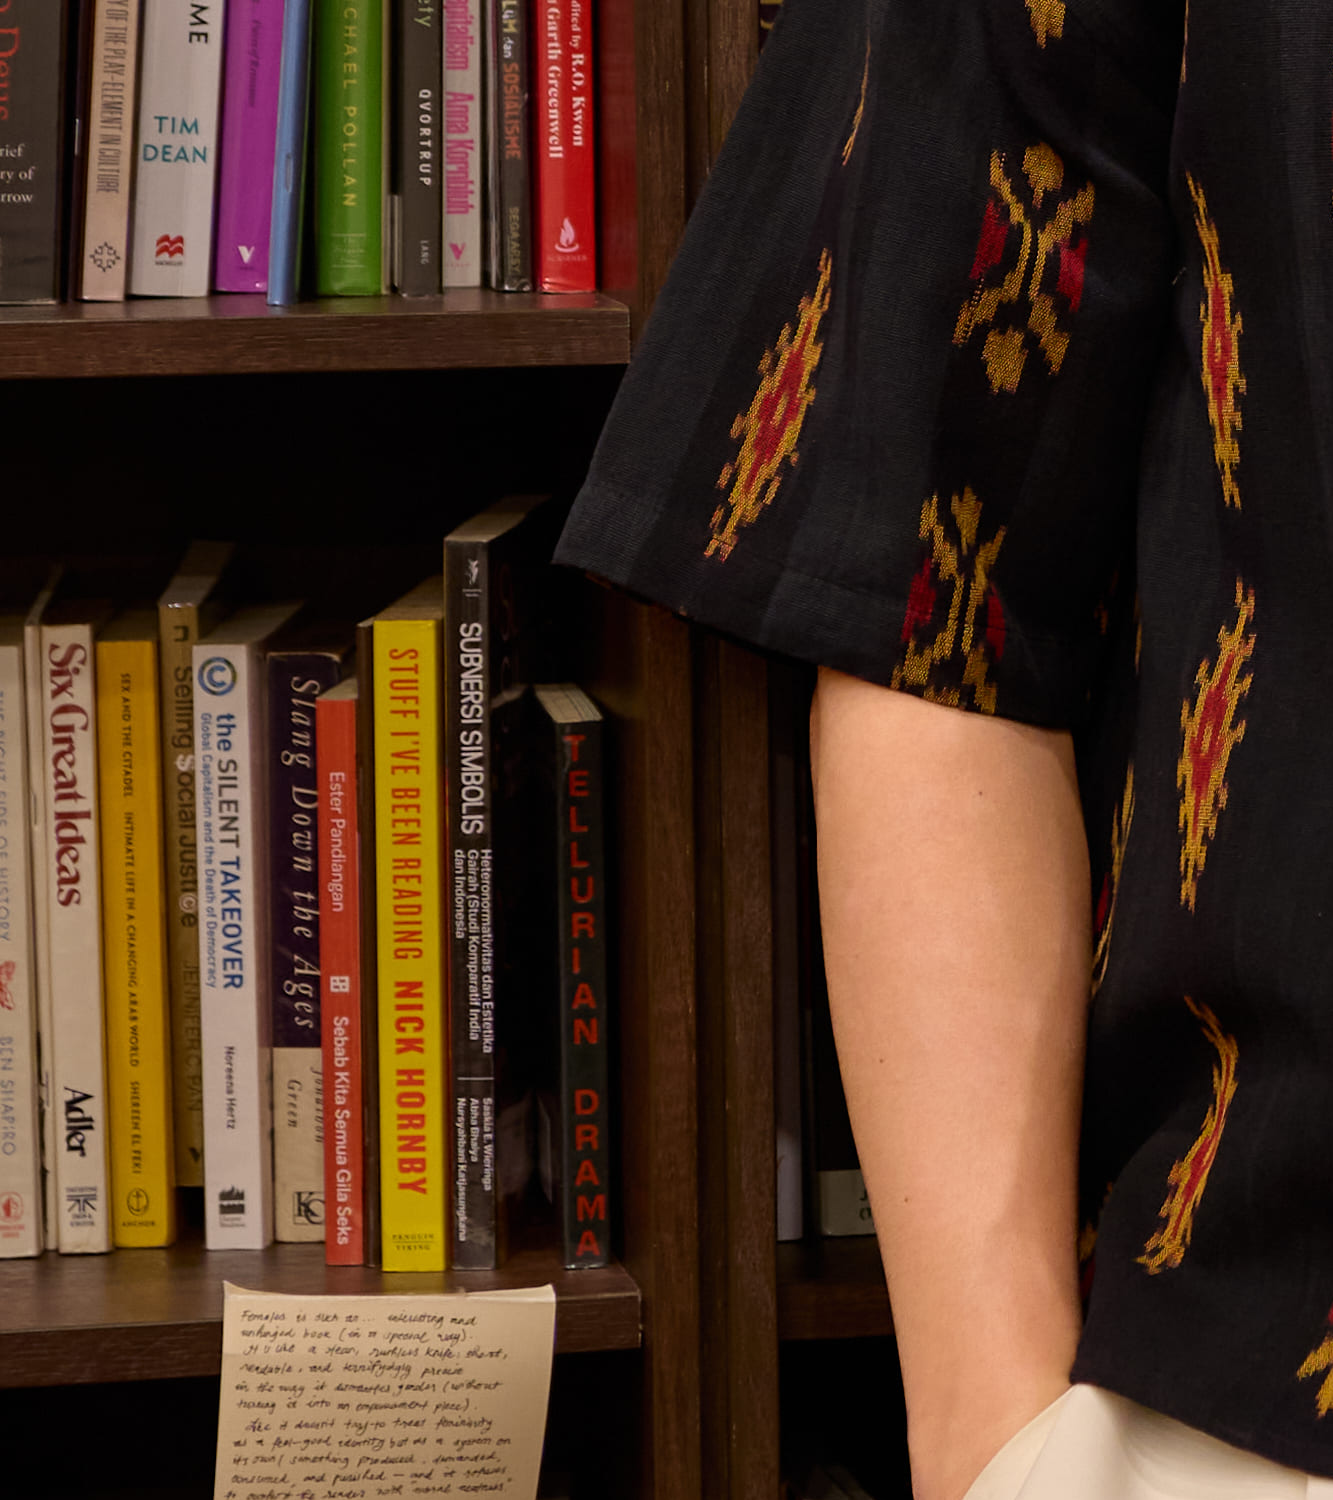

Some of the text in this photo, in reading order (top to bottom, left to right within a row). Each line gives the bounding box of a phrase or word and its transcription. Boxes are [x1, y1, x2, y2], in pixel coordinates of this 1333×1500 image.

[143, 144, 209, 161] DEAN
[154, 116, 200, 133] TIM
[417, 89, 433, 186] QVORTRUP
[48, 643, 90, 906] Six Great Ideas
[217, 712, 244, 989] the SILENT TAKEOVER
[389, 647, 428, 1196] STUFF I'VE BEEN READING NICK HORNBY
[63, 1086, 94, 1157] Adler
